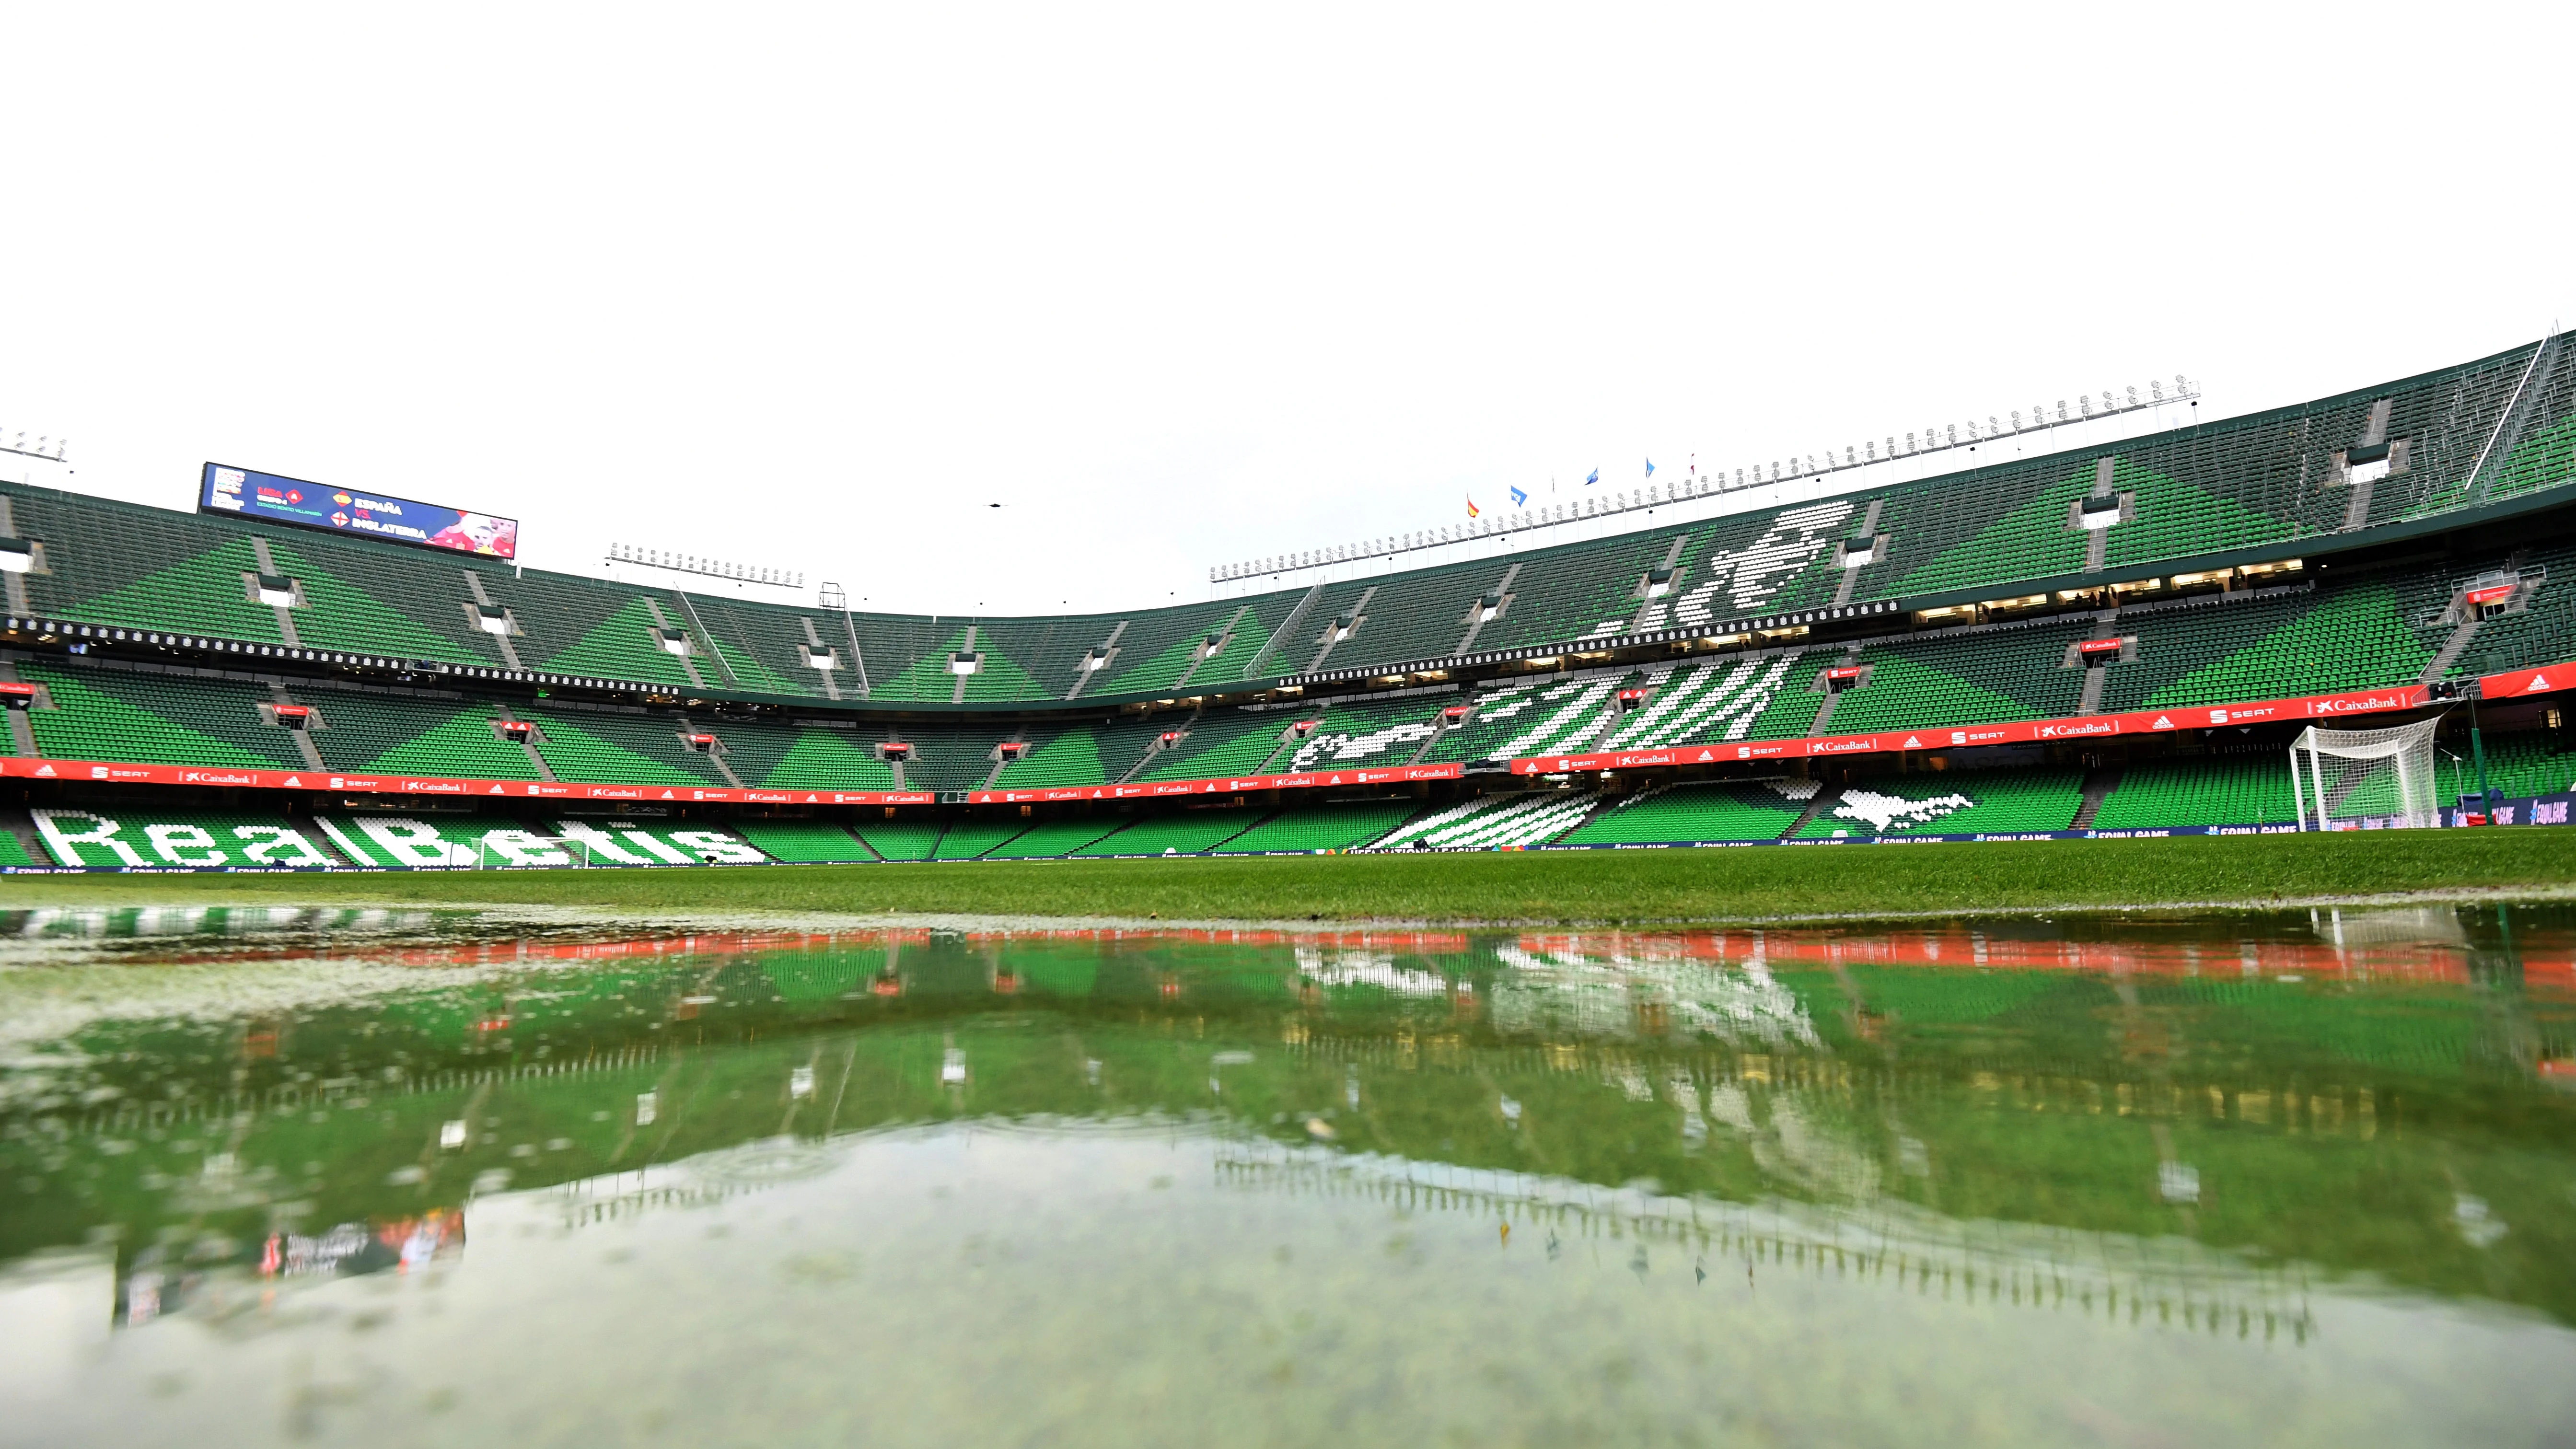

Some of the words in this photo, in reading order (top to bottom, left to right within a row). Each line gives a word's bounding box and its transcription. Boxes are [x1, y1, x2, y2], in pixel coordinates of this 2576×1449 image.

[354, 498, 402, 516] ESPAÑA
[352, 517, 427, 539] INGLATERRA
[2334, 697, 2398, 711] CaixaBank
[2231, 708, 2274, 719] SEAT
[2057, 723, 2112, 735] CaixaBank
[1969, 731, 2005, 740] SEAT
[1825, 741, 1871, 752] CaixaBank
[1632, 755, 1670, 764] CaixaBank
[201, 773, 250, 784] CaixaBank
[420, 783, 461, 791] CaixaBank
[31, 809, 378, 867] Real
